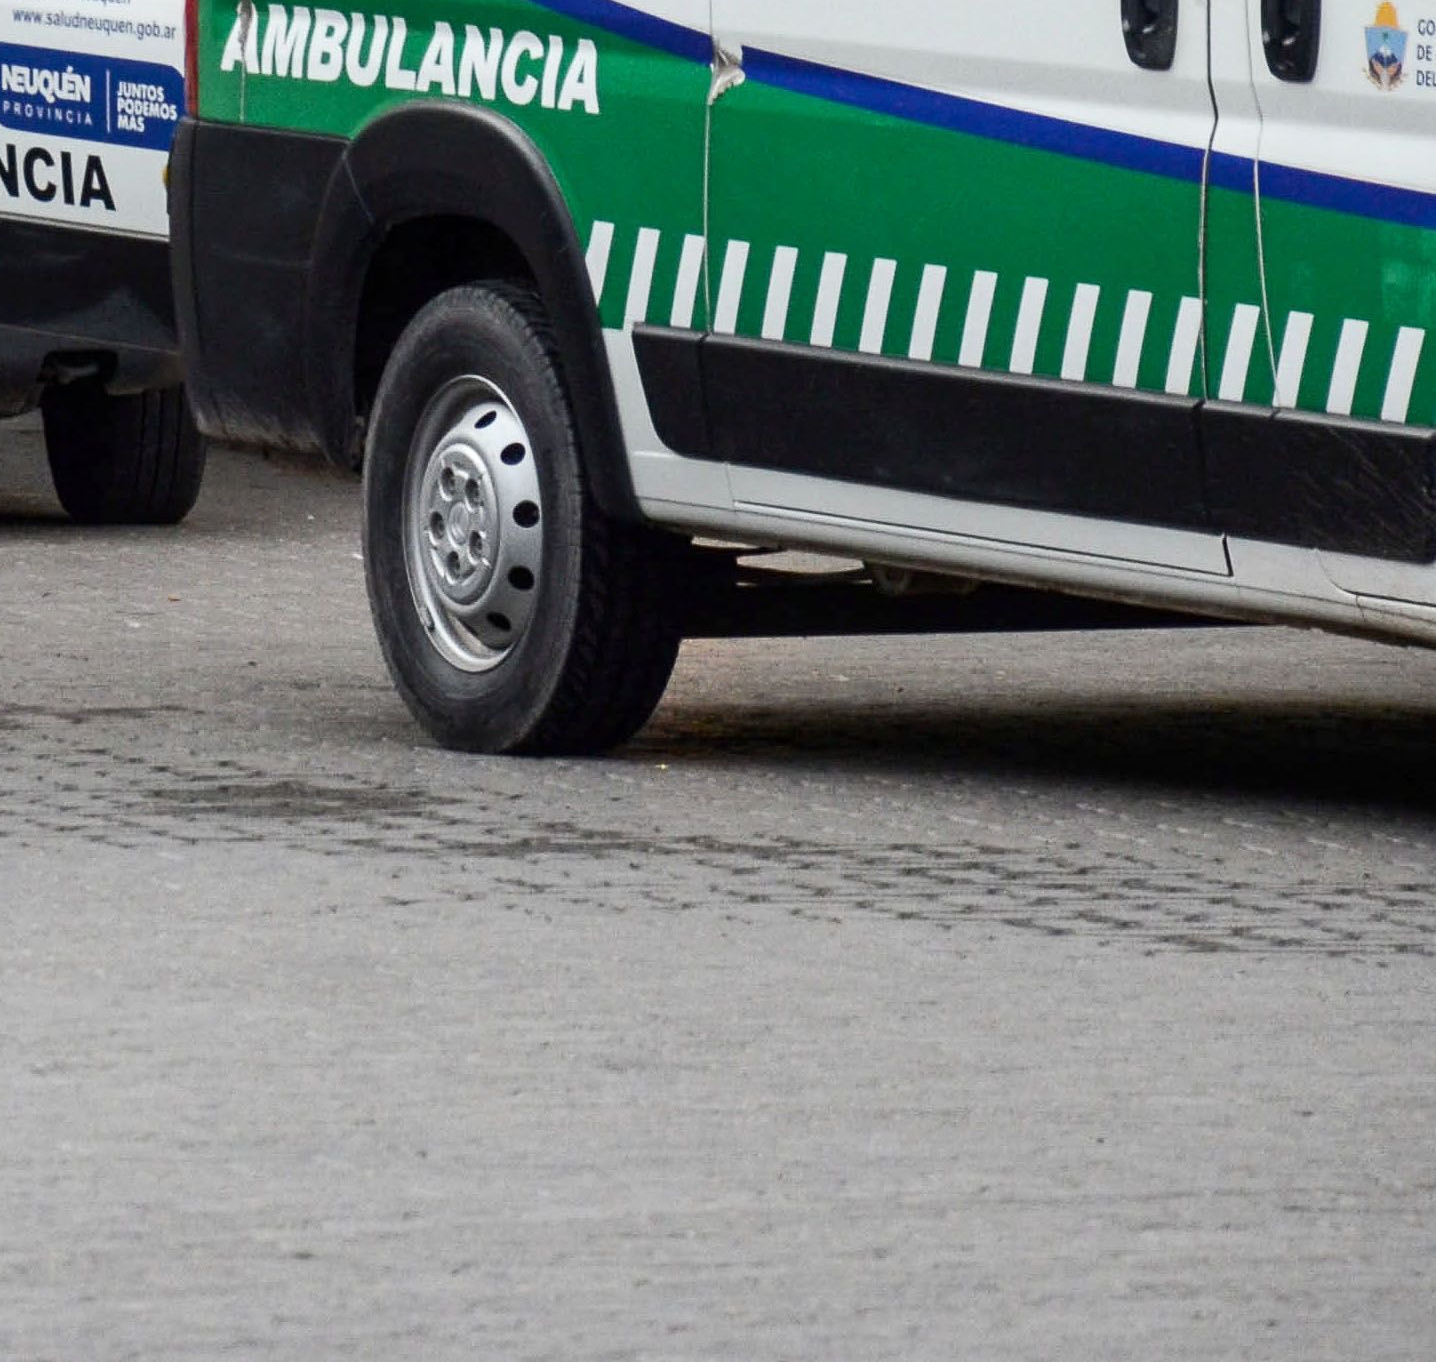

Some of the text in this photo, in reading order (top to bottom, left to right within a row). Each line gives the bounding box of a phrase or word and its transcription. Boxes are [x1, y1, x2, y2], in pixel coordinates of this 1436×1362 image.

[12, 7, 177, 40] www.saludneuquen.gob.ar
[220, 0, 600, 114] AMBULANCIA
[1416, 44, 1433, 62] DE
[1, 65, 91, 104] NEUQUÉN
[116, 81, 165, 103] JUNTOS
[2, 101, 93, 127] PROVINCIA
[116, 97, 178, 121] PODEMOS
